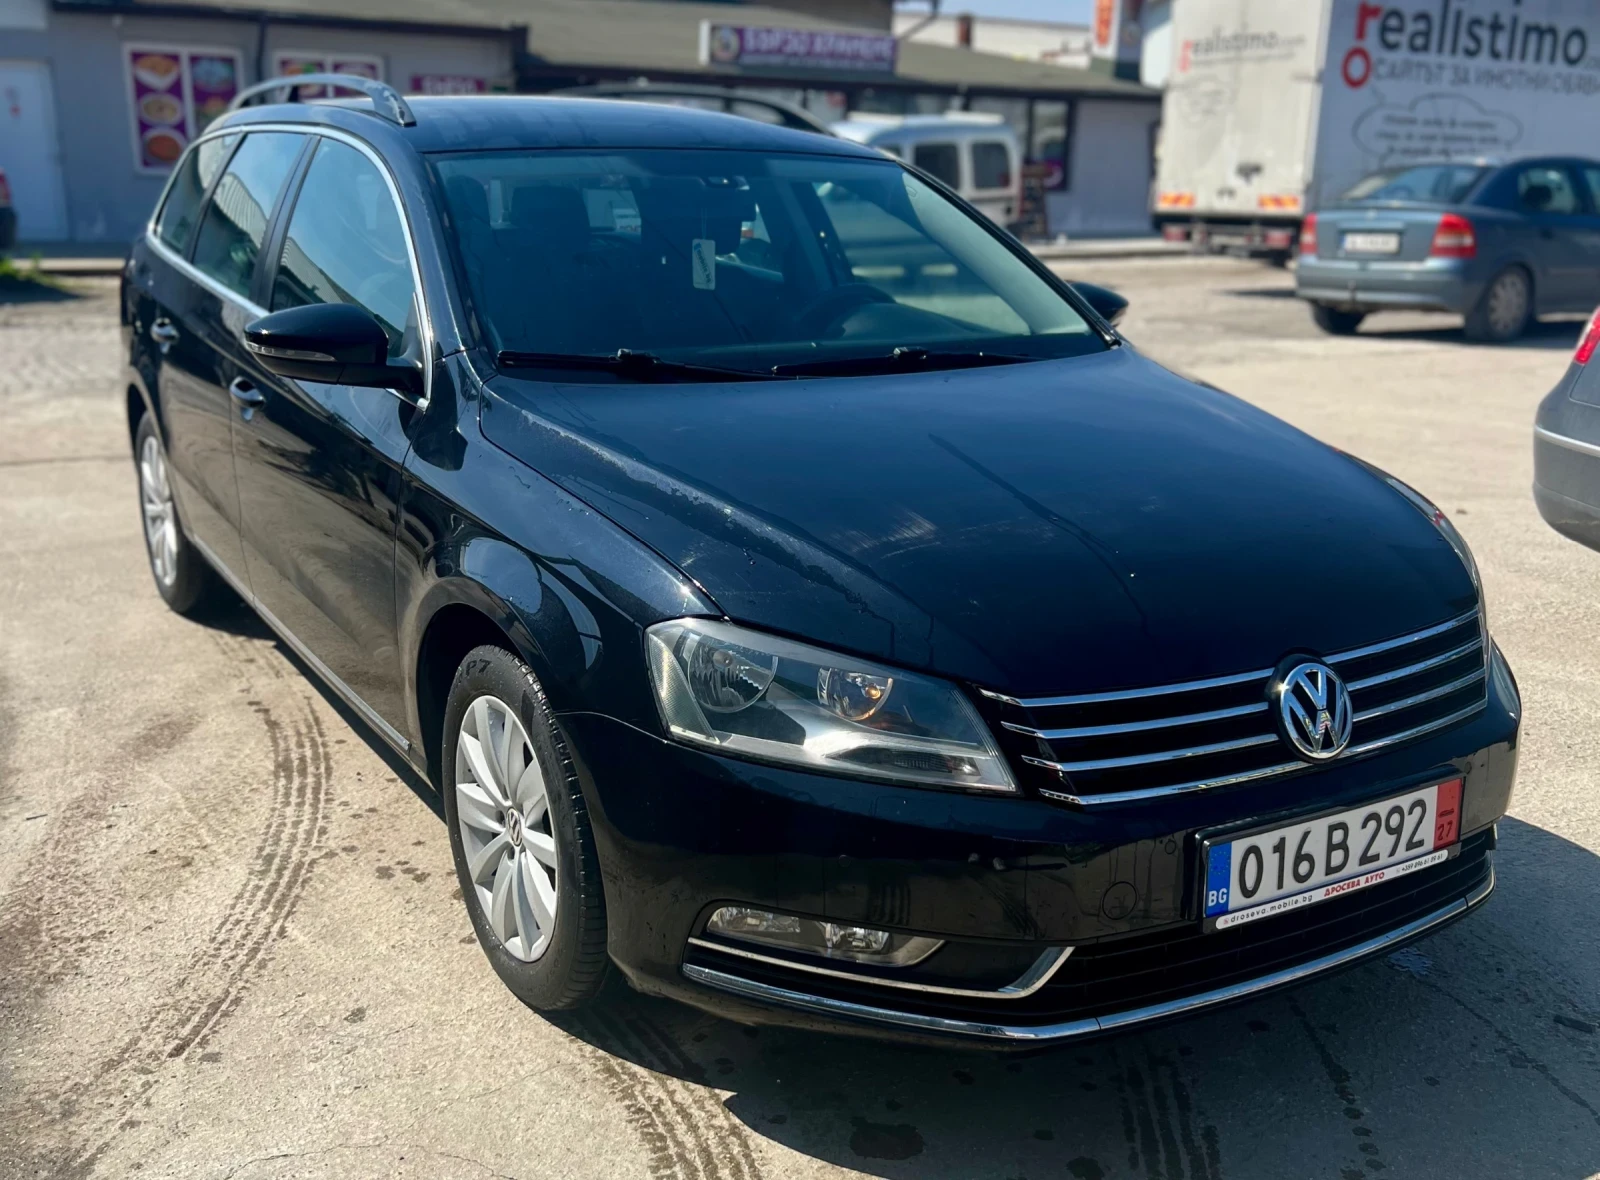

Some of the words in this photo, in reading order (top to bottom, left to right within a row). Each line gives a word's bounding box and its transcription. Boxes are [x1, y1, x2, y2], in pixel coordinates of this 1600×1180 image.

[1323, 879, 1361, 897] ДРОСЕВА
[1364, 871, 1385, 885] АУТО
[1208, 888, 1228, 907] BG
[1230, 894, 1313, 923] droseva.mobile.bg
